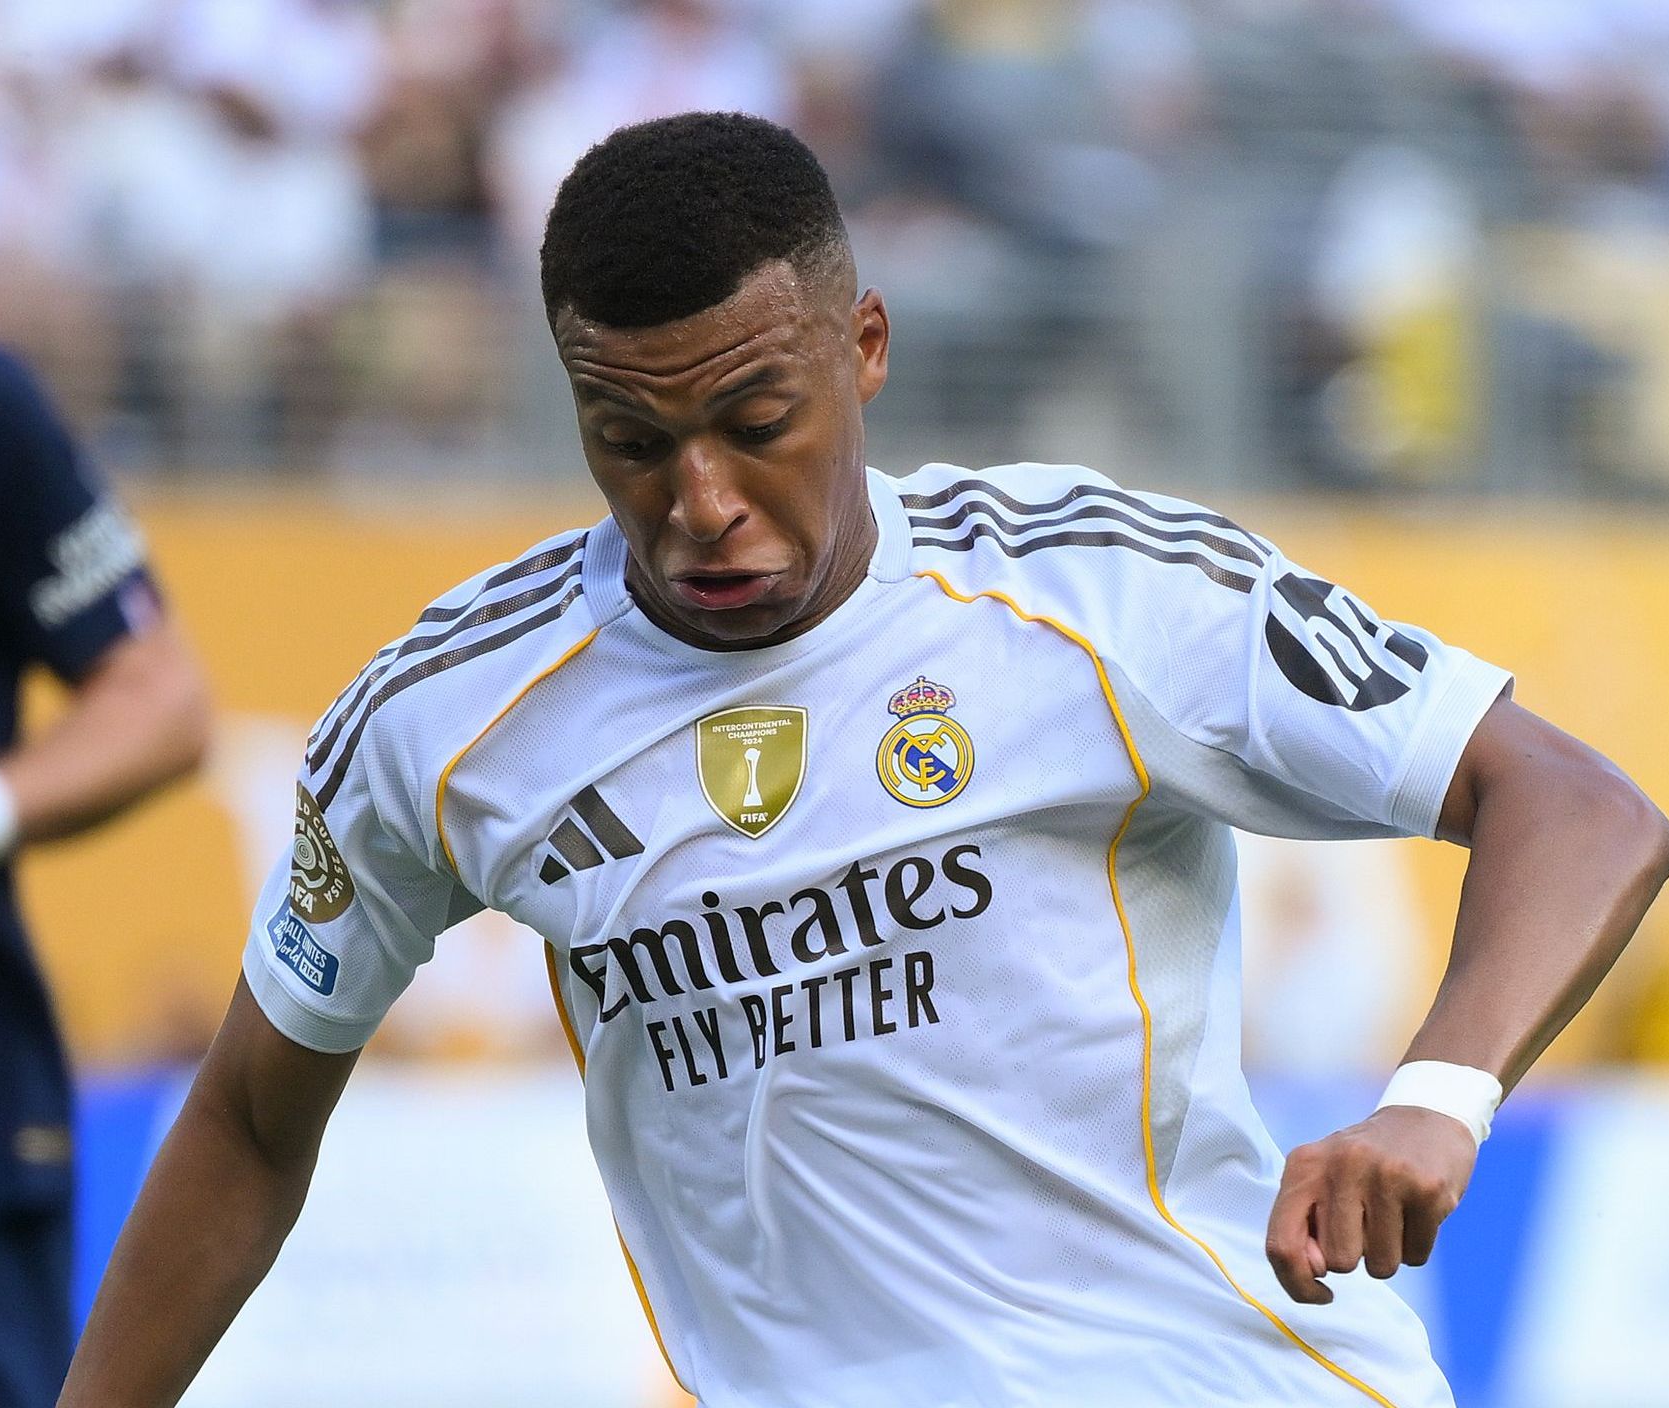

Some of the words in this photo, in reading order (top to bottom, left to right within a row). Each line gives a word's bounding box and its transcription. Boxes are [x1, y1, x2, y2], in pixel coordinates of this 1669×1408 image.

[712, 719, 792, 733] INTERCONTINENTAL
[728, 728, 778, 740] CHAMPIONS
[313, 816, 334, 849] CUP
[740, 812, 767, 824] FIFA
[289, 880, 314, 914] IFA
[323, 877, 344, 903] USA
[570, 844, 993, 1024] Emirates
[302, 933, 327, 968] UNITES
[301, 961, 320, 983] FIFA
[647, 1007, 728, 1092] FLY
[740, 951, 940, 1070] BETTER
